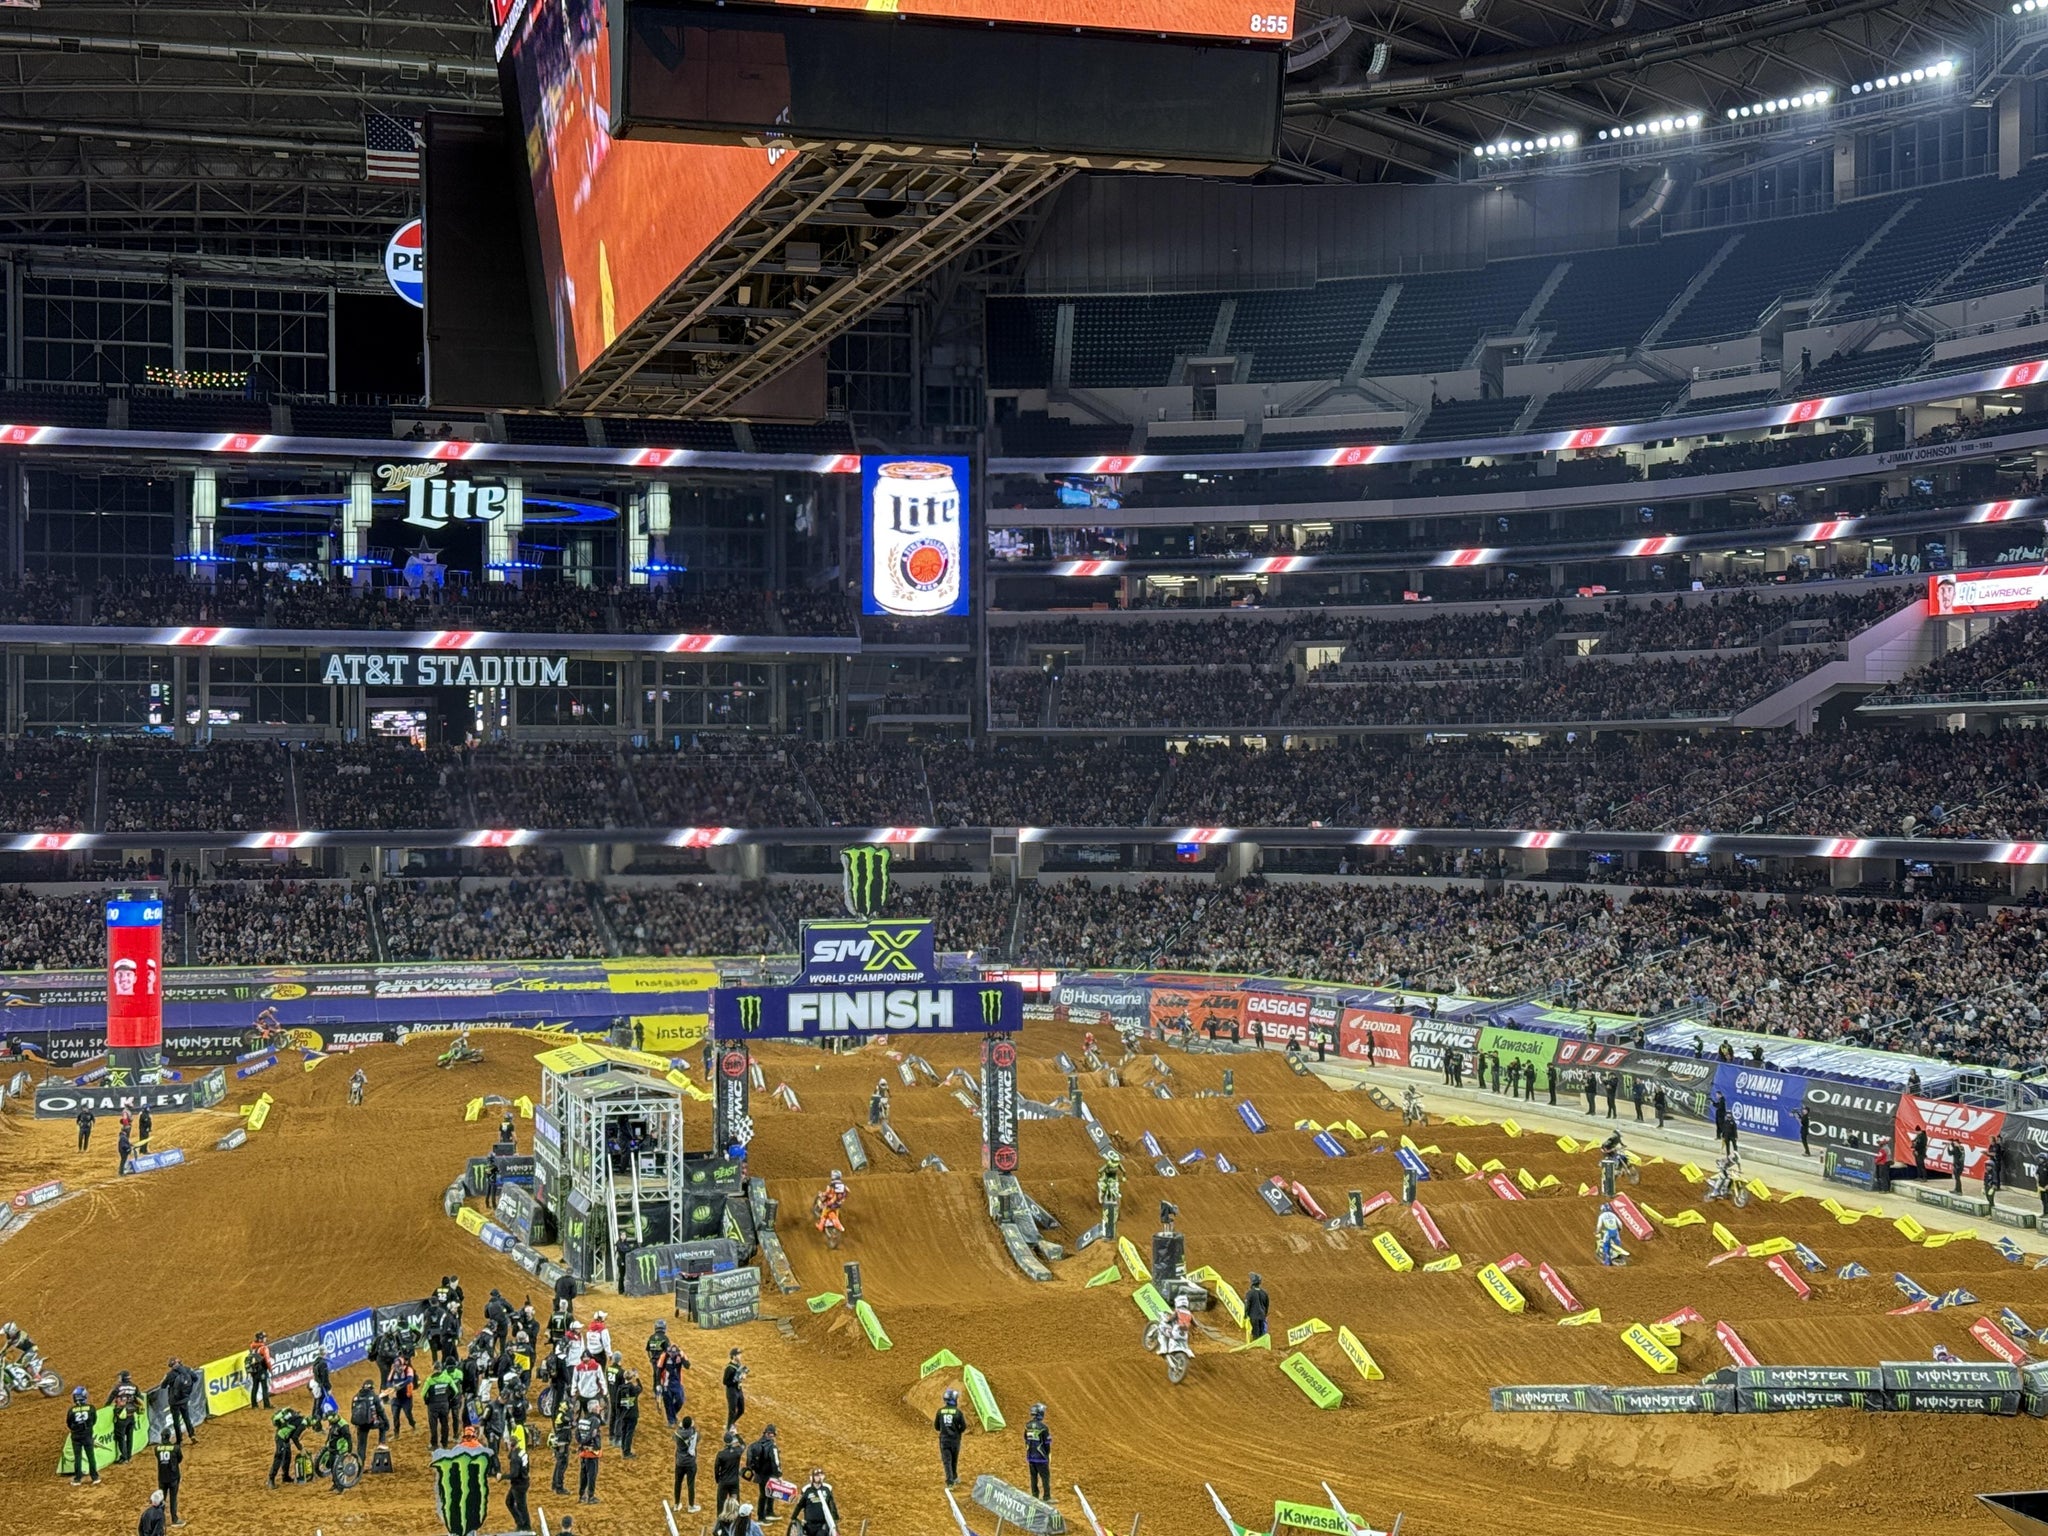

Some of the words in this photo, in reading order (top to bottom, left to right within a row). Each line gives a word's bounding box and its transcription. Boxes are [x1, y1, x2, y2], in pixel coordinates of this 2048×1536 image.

[1250, 14, 1288, 34] 8:55
[1888, 450, 1914, 463] JIMMY
[1915, 444, 1957, 459] JOHNSON
[377, 462, 447, 491] Miller
[402, 477, 506, 529] Lite
[889, 493, 955, 535] Lite
[1978, 587, 2033, 599] LAWRENCE
[322, 654, 409, 686] AT&T
[418, 655, 568, 687] STADIUM
[810, 929, 922, 971] SMX
[809, 973, 846, 983] WORLD
[847, 971, 924, 983] CHAMPIONSHIP
[316, 984, 367, 993] TRACKER
[1074, 991, 1142, 1006] Husqvarna
[1157, 994, 1190, 1007] KTM
[1201, 994, 1239, 1009] KTM
[788, 989, 954, 1032] FINISH
[1247, 997, 1306, 1017] GASGAS
[411, 1022, 447, 1032] ROCKY
[1361, 1019, 1401, 1034] HONDA
[1423, 1020, 1442, 1031] ROCKY
[1443, 1023, 1478, 1036] MOUNTAIN
[51, 1039, 84, 1048] UTAH
[165, 1035, 243, 1048] MONSTER
[333, 1032, 384, 1043] TRACKER
[1492, 1035, 1544, 1056] Kawasaki
[1360, 1044, 1400, 1060] HNDA
[1667, 1061, 1710, 1077] amazon
[1747, 1073, 1784, 1095] YAMAHA
[1736, 1088, 1778, 1101] RACING
[1831, 1093, 1897, 1115] OAKLEY
[1742, 1101, 1779, 1127] YAMAHA
[1913, 1099, 1996, 1132] FLY
[1735, 1119, 1777, 1132] RACING
[1926, 1125, 1971, 1139] RACING
[1618, 1206, 1645, 1236] HONDA
[1379, 1235, 1407, 1266] SUZUKI
[1484, 1269, 1518, 1305] SUZUKI
[555, 1318, 562, 1329] 7
[334, 1317, 373, 1348] YAMAHA
[1289, 1323, 1314, 1343] SUZUKI
[330, 1339, 372, 1360] RACING
[1340, 1332, 1368, 1373] SUZUKI
[1628, 1328, 1669, 1366] SUZUKI
[1981, 1333, 2014, 1363] HONDA
[1290, 1359, 1332, 1398] Kawasaki
[1772, 1369, 1849, 1382] MONSTER
[1916, 1369, 1991, 1383] MONSTER
[1515, 1390, 1570, 1404] MONSTER
[1630, 1392, 1697, 1408] MONSTER
[1773, 1391, 1844, 1405] MONSTER
[1915, 1395, 1985, 1409] MONSTER
[75, 1411, 88, 1422] 23
[943, 1414, 953, 1424] 19
[159, 1450, 170, 1462] 10
[993, 1488, 1026, 1515] MONSTER
[1283, 1508, 1348, 1533] Kawasaki
